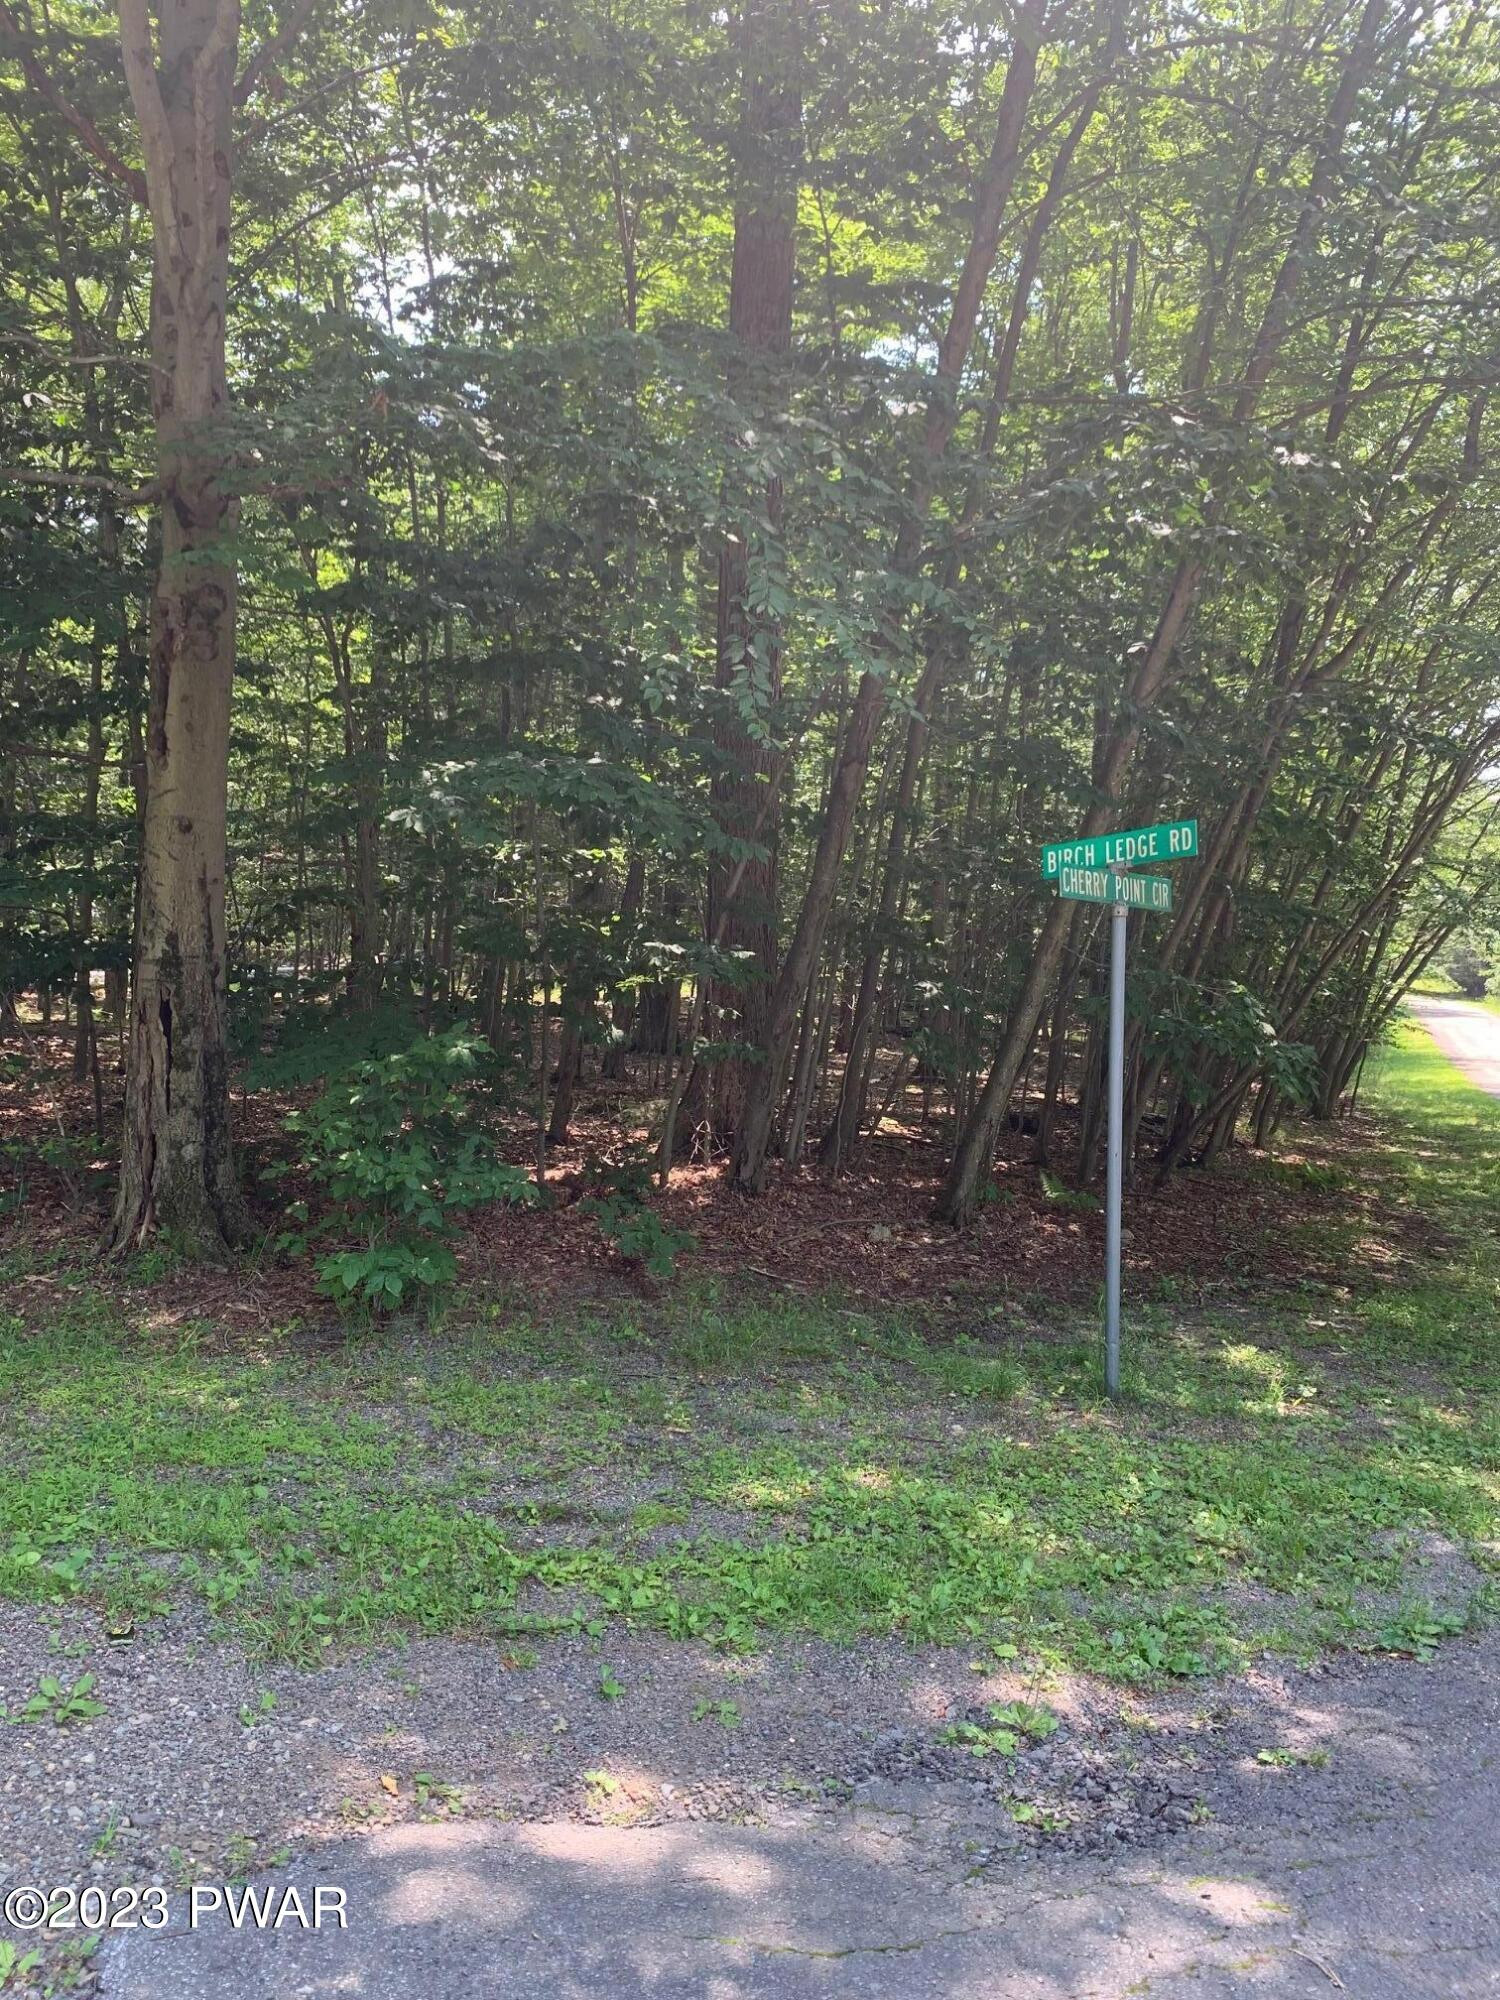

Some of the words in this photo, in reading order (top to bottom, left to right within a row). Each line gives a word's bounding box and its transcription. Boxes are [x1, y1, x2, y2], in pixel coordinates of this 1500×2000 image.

[1047, 844, 1095, 873] BIRCH
[1105, 833, 1159, 863] LEDGE
[1169, 827, 1192, 853] RD
[1061, 867, 1108, 898] CHERRY
[1115, 875, 1146, 903] POINT
[1152, 882, 1169, 907] CIR
